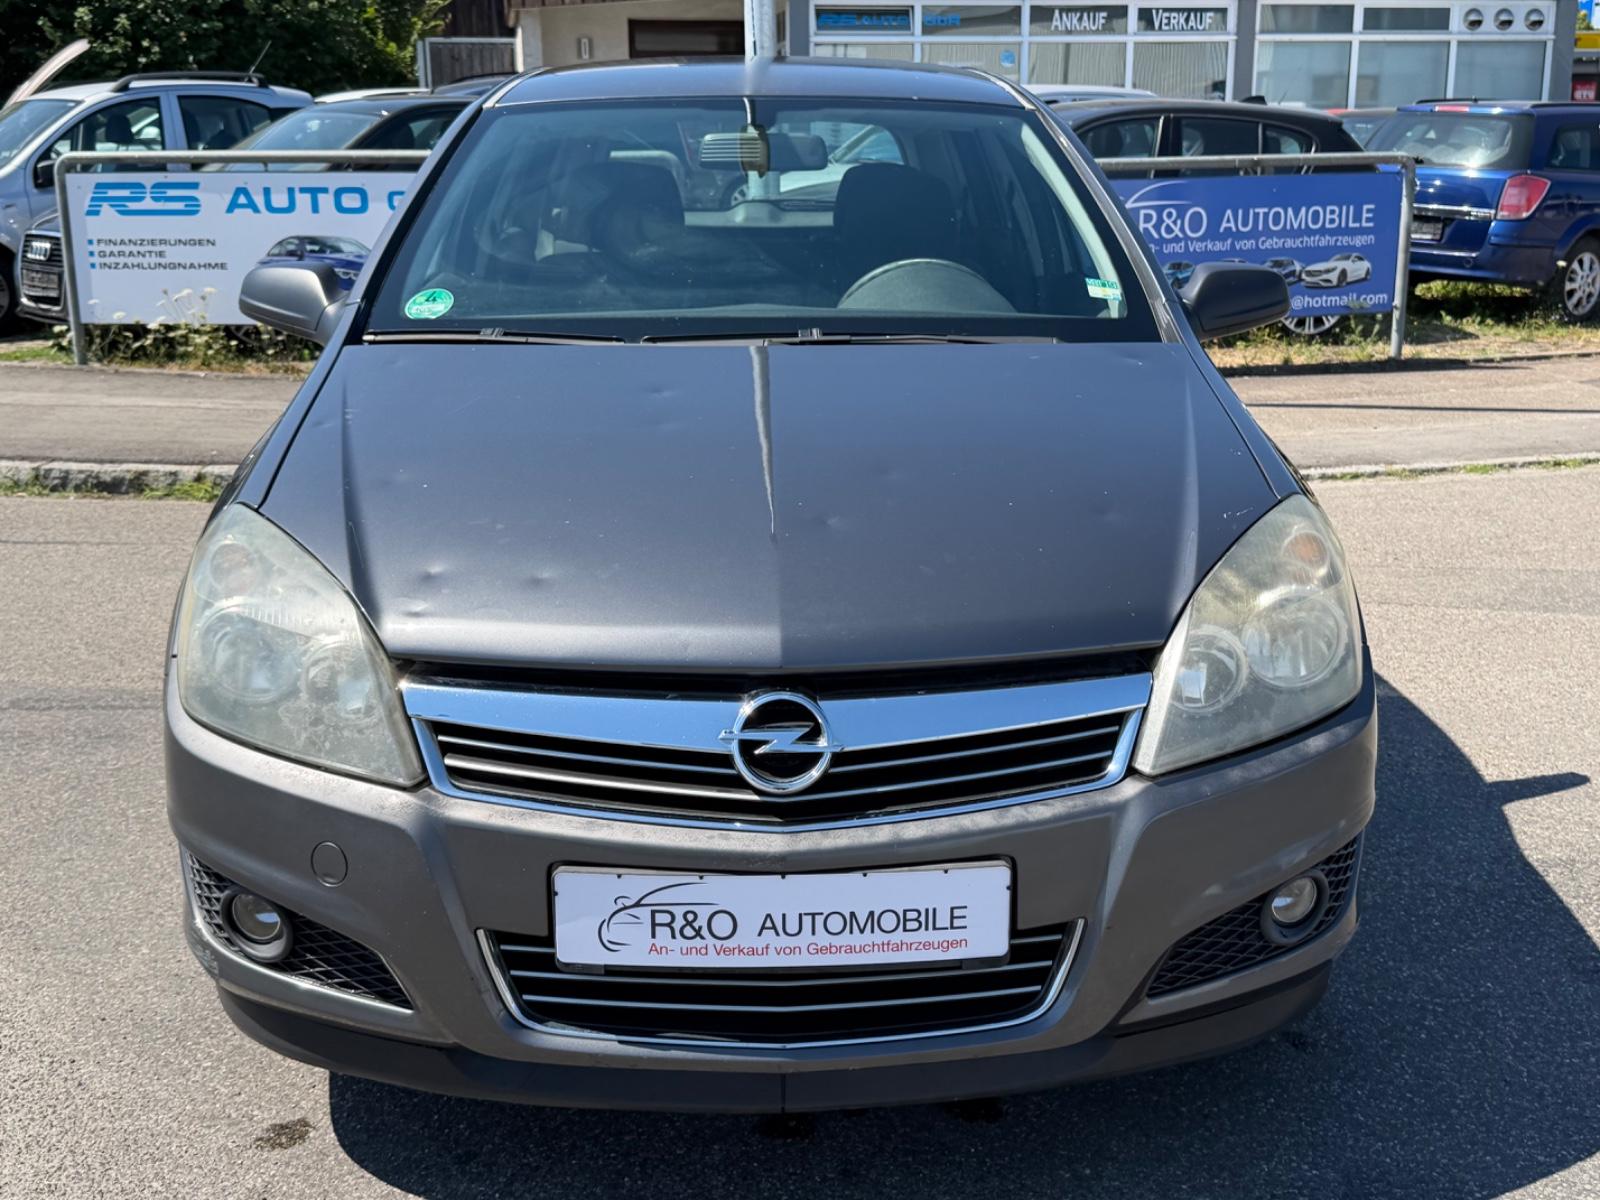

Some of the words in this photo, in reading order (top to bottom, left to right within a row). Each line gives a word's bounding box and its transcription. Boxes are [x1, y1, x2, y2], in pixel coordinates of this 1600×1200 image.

[85, 182, 202, 216] RS
[225, 187, 369, 214] AUTO
[1139, 207, 1208, 239] R&O
[1219, 204, 1376, 233] AUTOMOBILE
[96, 238, 217, 247] FINANZIERUNGEN
[1162, 241, 1185, 254] und
[1187, 237, 1232, 252] Verkauf
[1234, 239, 1256, 250] von
[1258, 234, 1375, 249] Gebrauchtfahrzeugen
[97, 250, 167, 259] GARANTIE
[99, 262, 228, 271] INZAHLUNGNAHME
[1291, 292, 1388, 310] @hotmailcom
[650, 909, 738, 941] R&O
[757, 905, 968, 938] AUTOMOBILE
[648, 943, 675, 956] An-
[680, 943, 708, 956] und
[713, 943, 770, 957] Verkauf
[774, 945, 802, 956] von
[807, 938, 968, 956] Gebrauchtfahrzeugen
